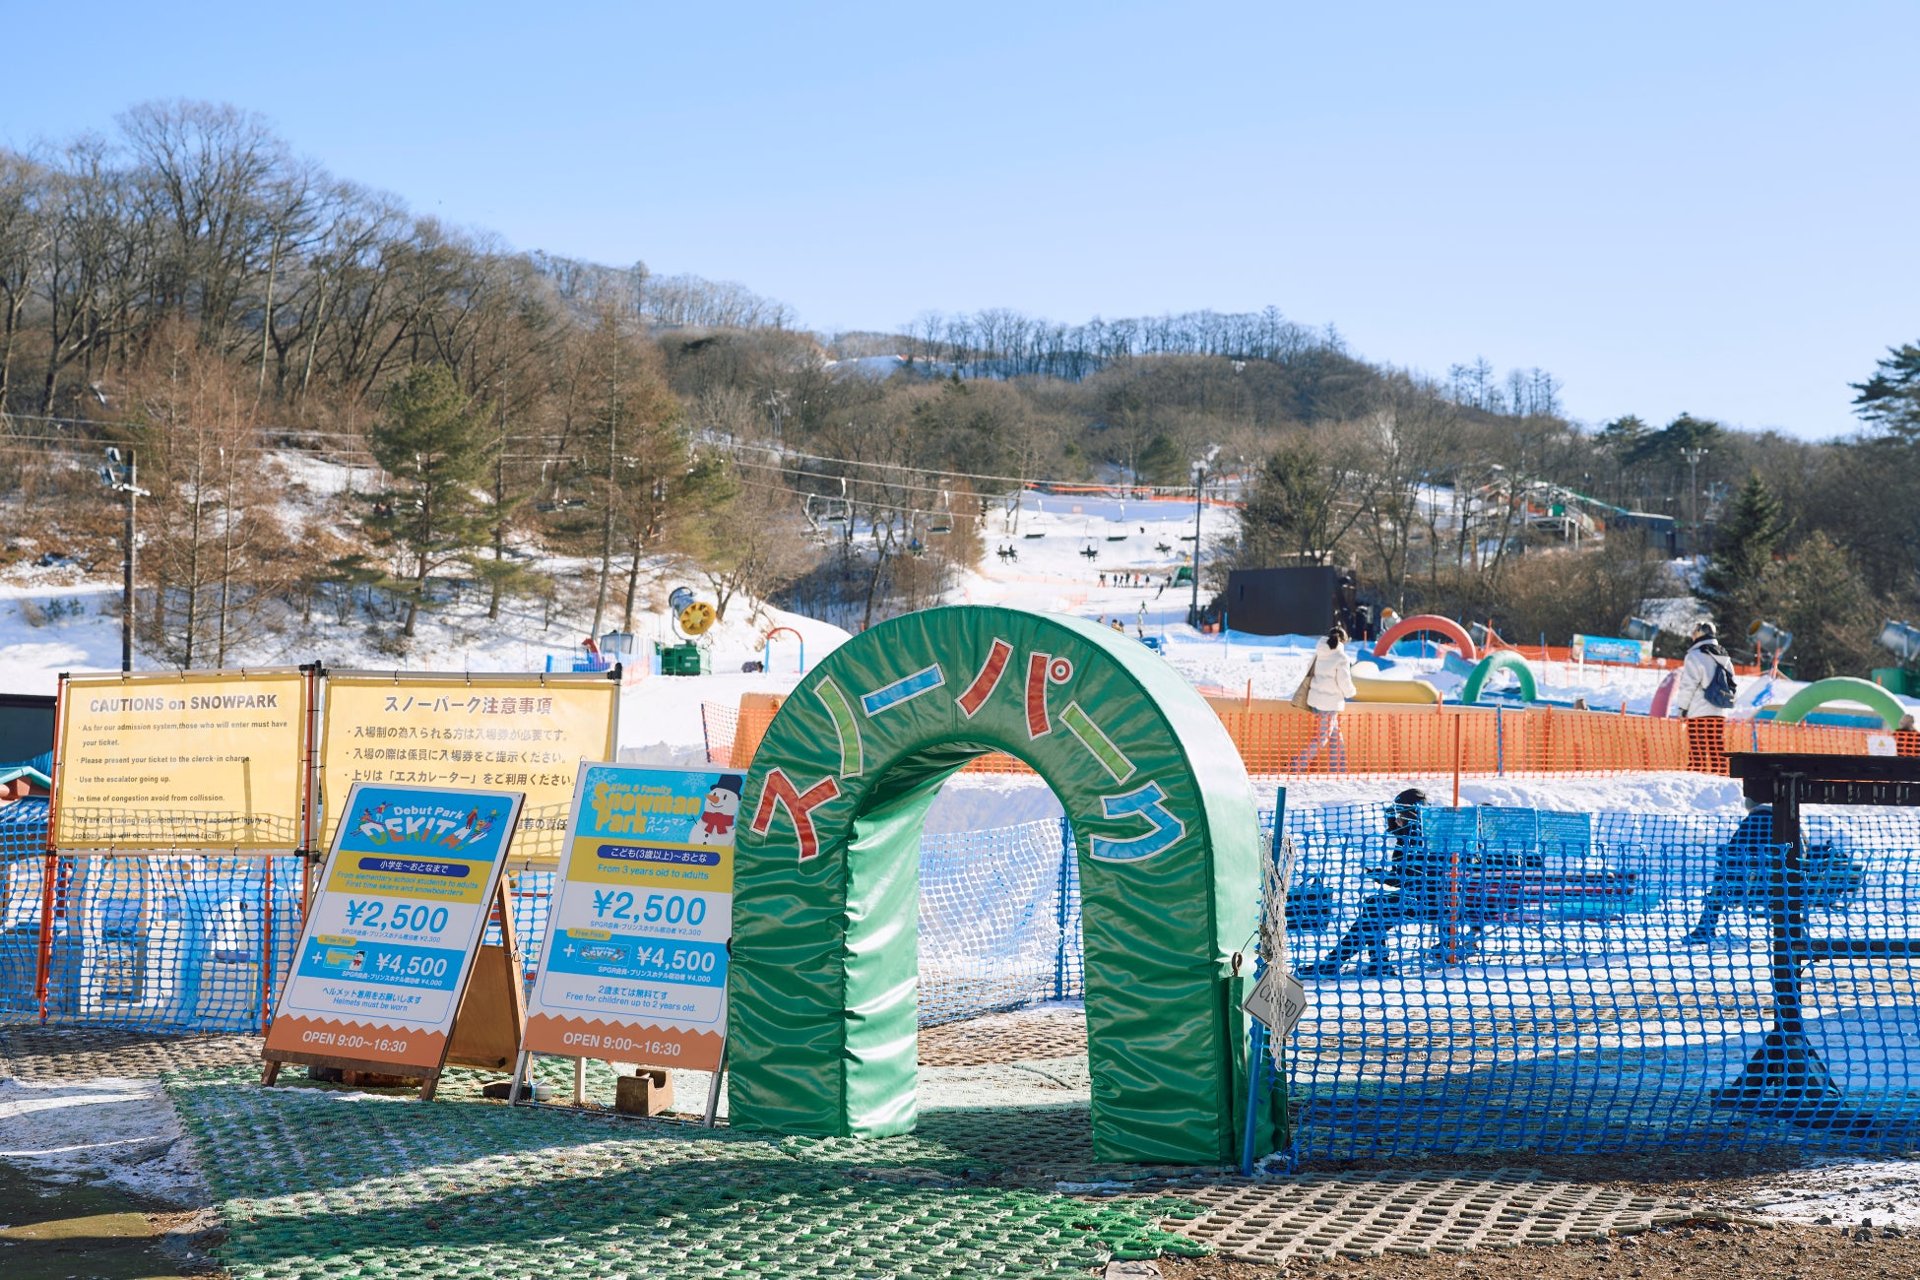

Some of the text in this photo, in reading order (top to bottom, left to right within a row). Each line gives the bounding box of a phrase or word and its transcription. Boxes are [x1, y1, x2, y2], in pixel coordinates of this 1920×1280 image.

[90, 694, 277, 712] CAUTIONS on SNOWPARK
[385, 696, 553, 714] スノーパーク注意事項
[117, 723, 151, 731] admission
[216, 721, 230, 729] will
[750, 637, 1186, 863] スノーパーク
[104, 757, 130, 765] present
[140, 776, 159, 784] going
[111, 794, 149, 803] congestion
[150, 794, 170, 802] avoid
[171, 794, 188, 802] from
[592, 782, 701, 816] Snowman
[394, 805, 466, 820] Debut Park
[595, 808, 648, 834] Park
[648, 816, 687, 826] スノーマン
[598, 864, 709, 880] From 3 years old to adults
[346, 899, 448, 934] ¥2,500
[592, 889, 706, 926] ¥2,500
[376, 952, 448, 978] ¥4,500
[636, 946, 716, 973] ¥4,500
[322, 986, 422, 1005] ヘルメット着用をお願いします
[333, 997, 408, 1012] Helmets must be worn
[566, 992, 696, 1012] Free for children up to 2 years old.
[302, 1030, 336, 1046] OPEN
[563, 1032, 600, 1048] OPEN
